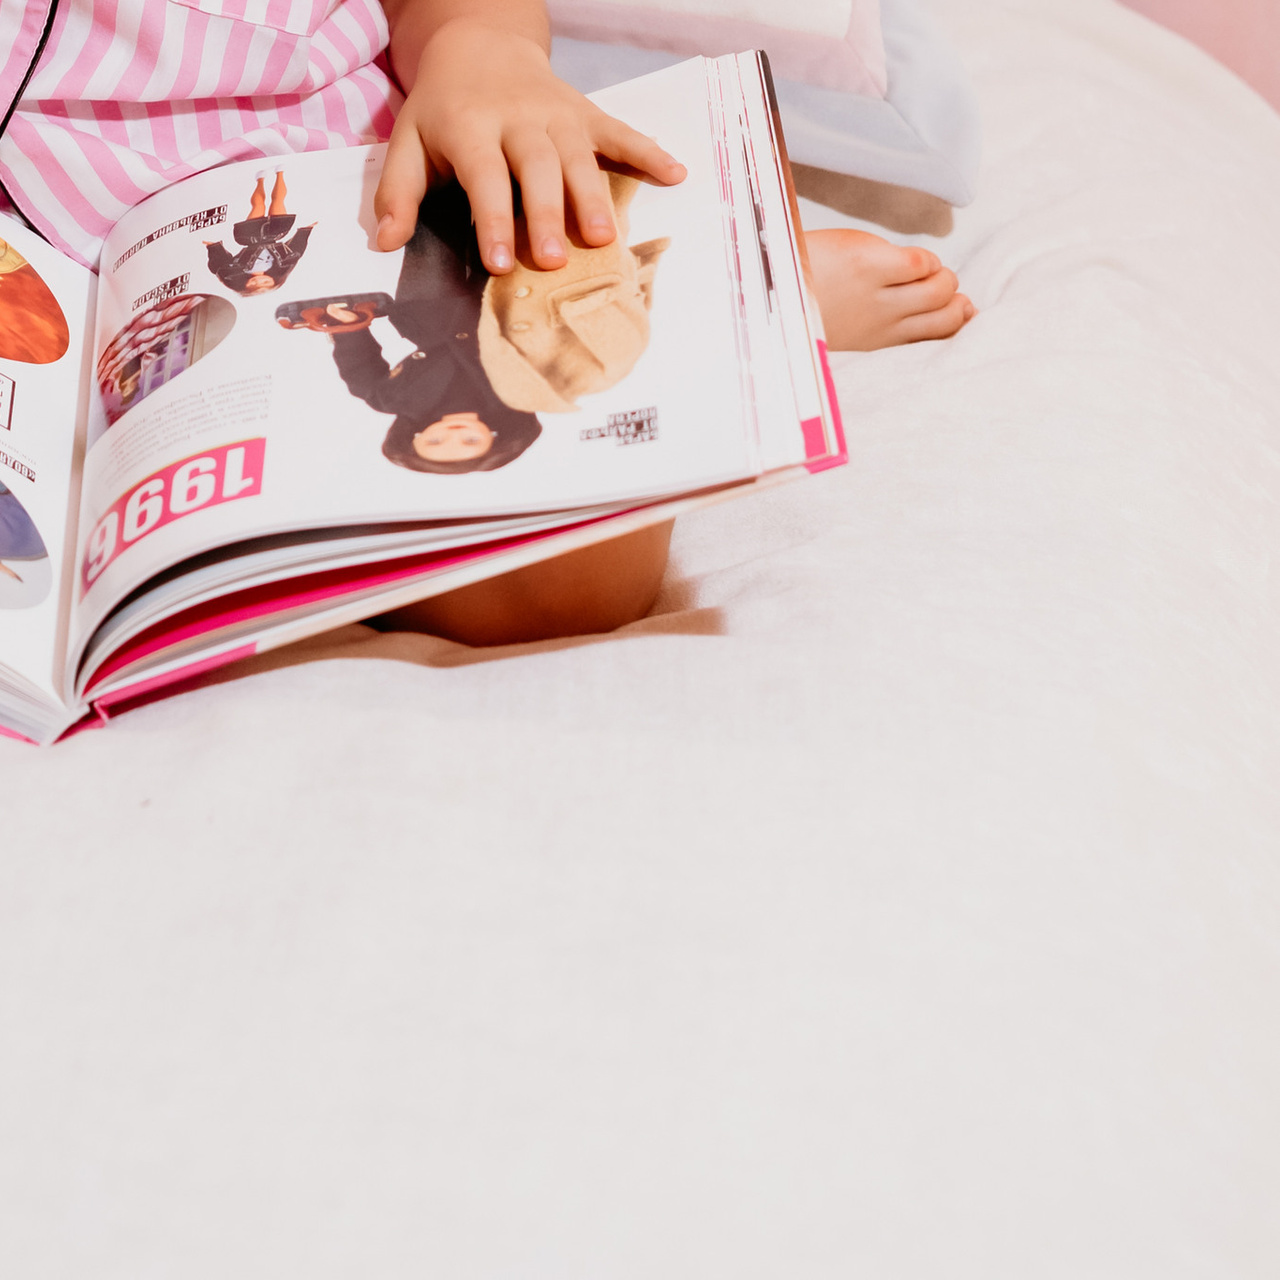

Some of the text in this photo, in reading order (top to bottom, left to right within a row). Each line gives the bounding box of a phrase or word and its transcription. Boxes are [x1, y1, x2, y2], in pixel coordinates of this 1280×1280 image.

[213, 205, 227, 216] ОТ
[190, 215, 226, 232] БАРБИ
[152, 284, 188, 305] БАРБИ
[88, 447, 252, 581] 1996
